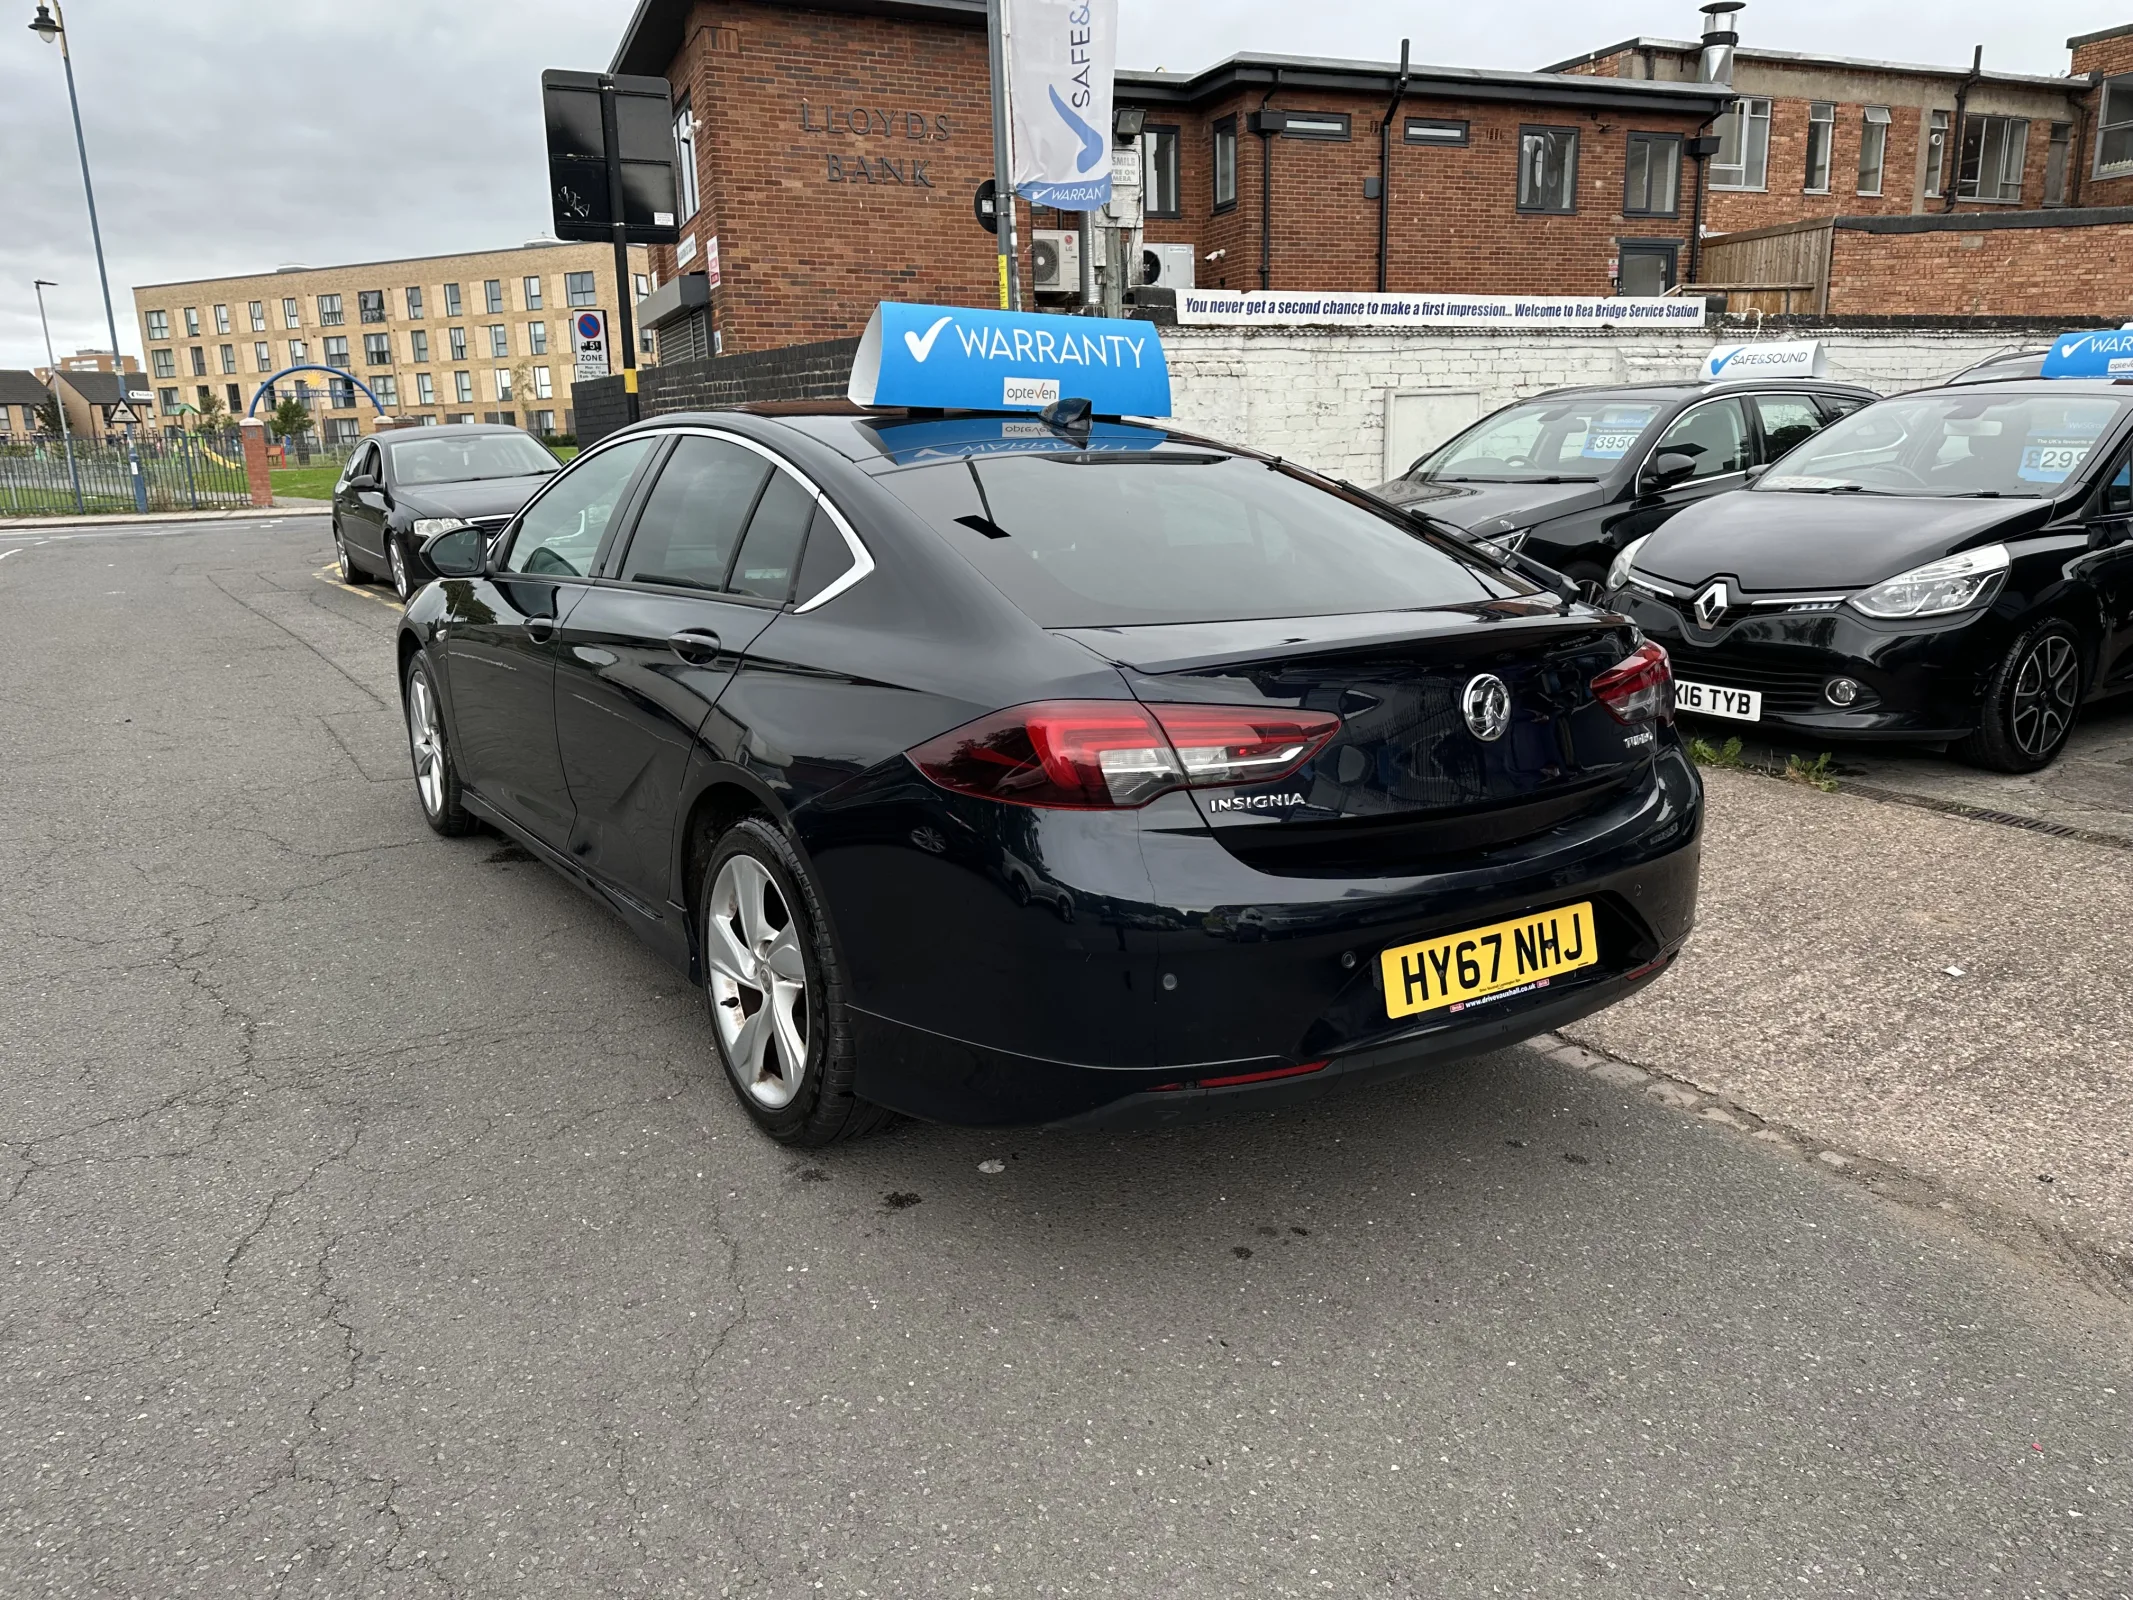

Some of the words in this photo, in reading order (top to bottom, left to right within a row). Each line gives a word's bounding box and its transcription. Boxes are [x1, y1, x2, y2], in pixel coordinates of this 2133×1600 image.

[802, 103, 950, 140] LLOYDS
[826, 154, 936, 188] BANK
[1052, 184, 1104, 201] WARRAN
[1186, 298, 1207, 313] You
[1210, 300, 1245, 314] never
[1246, 300, 1267, 316] get
[1268, 302, 1276, 314] a
[1278, 300, 1320, 315] second
[1322, 300, 1365, 315] chance
[1367, 300, 1379, 315] to
[1381, 301, 1411, 315] make
[1413, 303, 1420, 315] a
[1422, 301, 1445, 316] first
[1447, 301, 1513, 318] impression...
[1515, 303, 1562, 317] Welcome
[1563, 303, 1574, 317] to
[1575, 304, 1593, 318] Rea
[1595, 303, 1627, 319] Bridge
[1629, 304, 1665, 318] Service
[1665, 304, 1699, 318] Station
[955, 324, 1146, 369] WARRANTY
[1731, 352, 1808, 366] SAFE&SOUND
[1006, 382, 1057, 401] opteven
[1709, 688, 1752, 715] TYB
[1210, 792, 1306, 812] INSIGNIA
[1401, 933, 1502, 1006] HY67
[1514, 913, 1583, 975] NHJ
[1465, 983, 1537, 1008] www.drivevauxhall.co.uk
